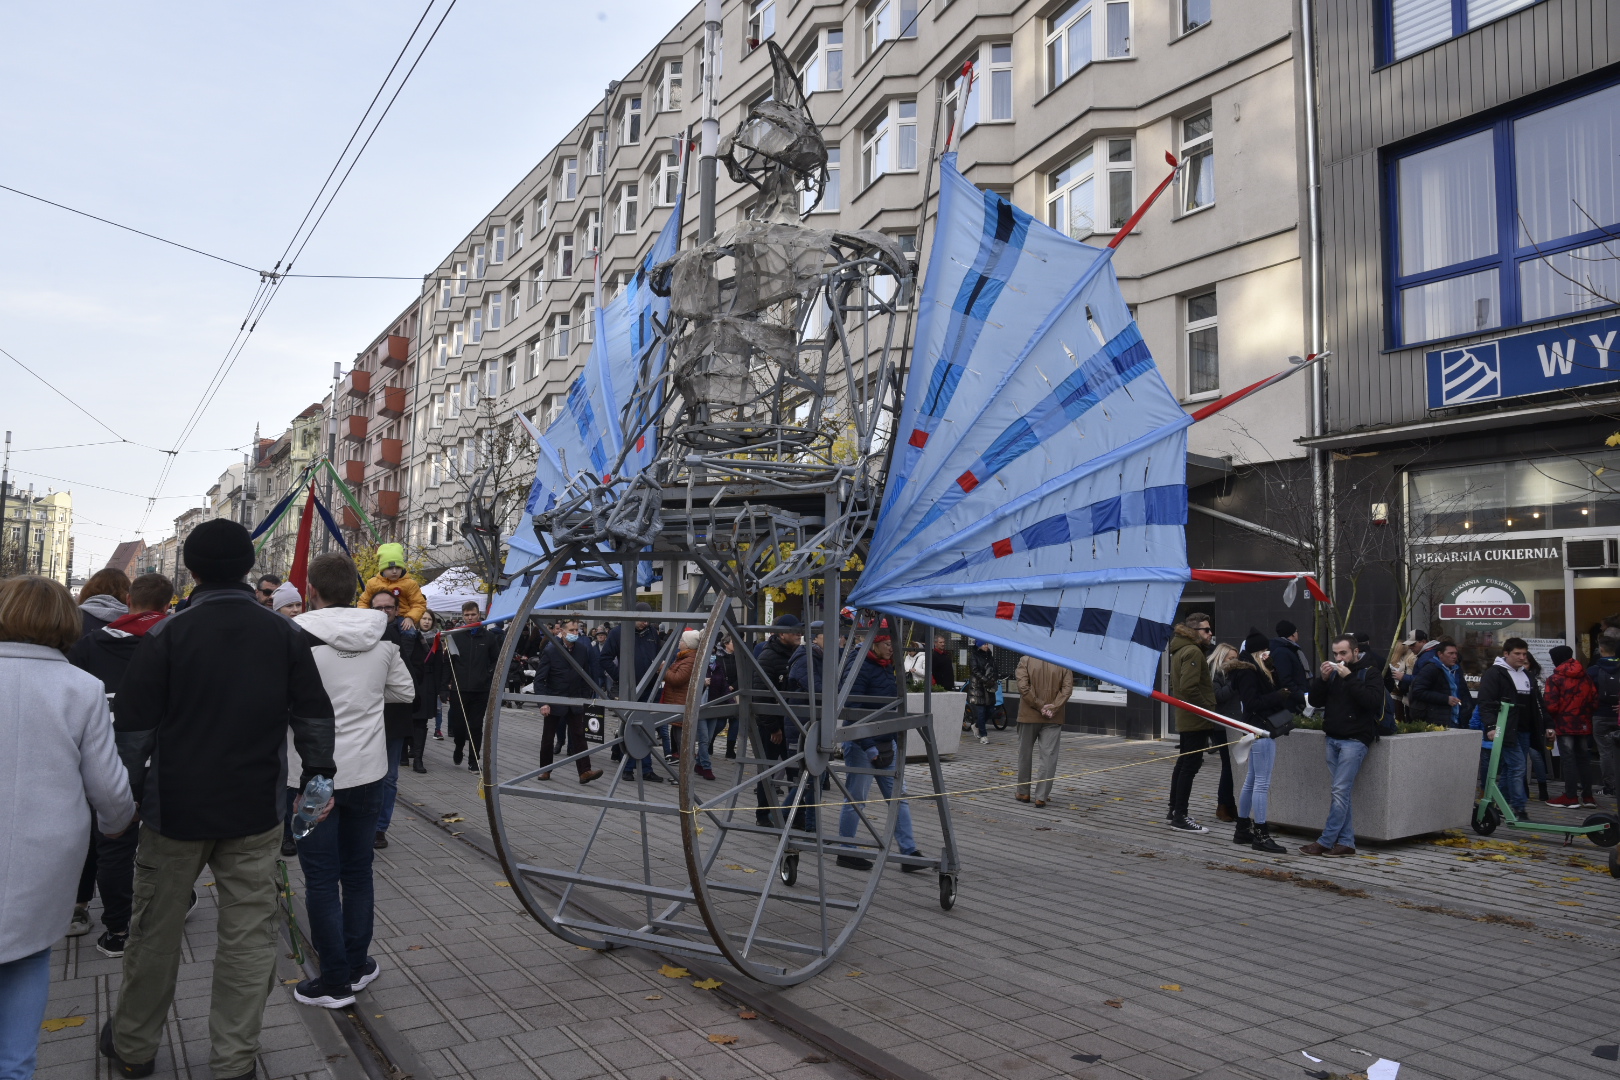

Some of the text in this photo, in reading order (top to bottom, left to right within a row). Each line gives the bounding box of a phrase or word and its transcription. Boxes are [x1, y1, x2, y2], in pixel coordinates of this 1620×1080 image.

[1537, 330, 1618, 378] WY
[1414, 547, 1559, 563] PIEKARNIA CUKIERNIA
[1451, 578, 1517, 597] PIEKARNIA CUKIERNIA
[1455, 607, 1513, 616] ŁAWICA
